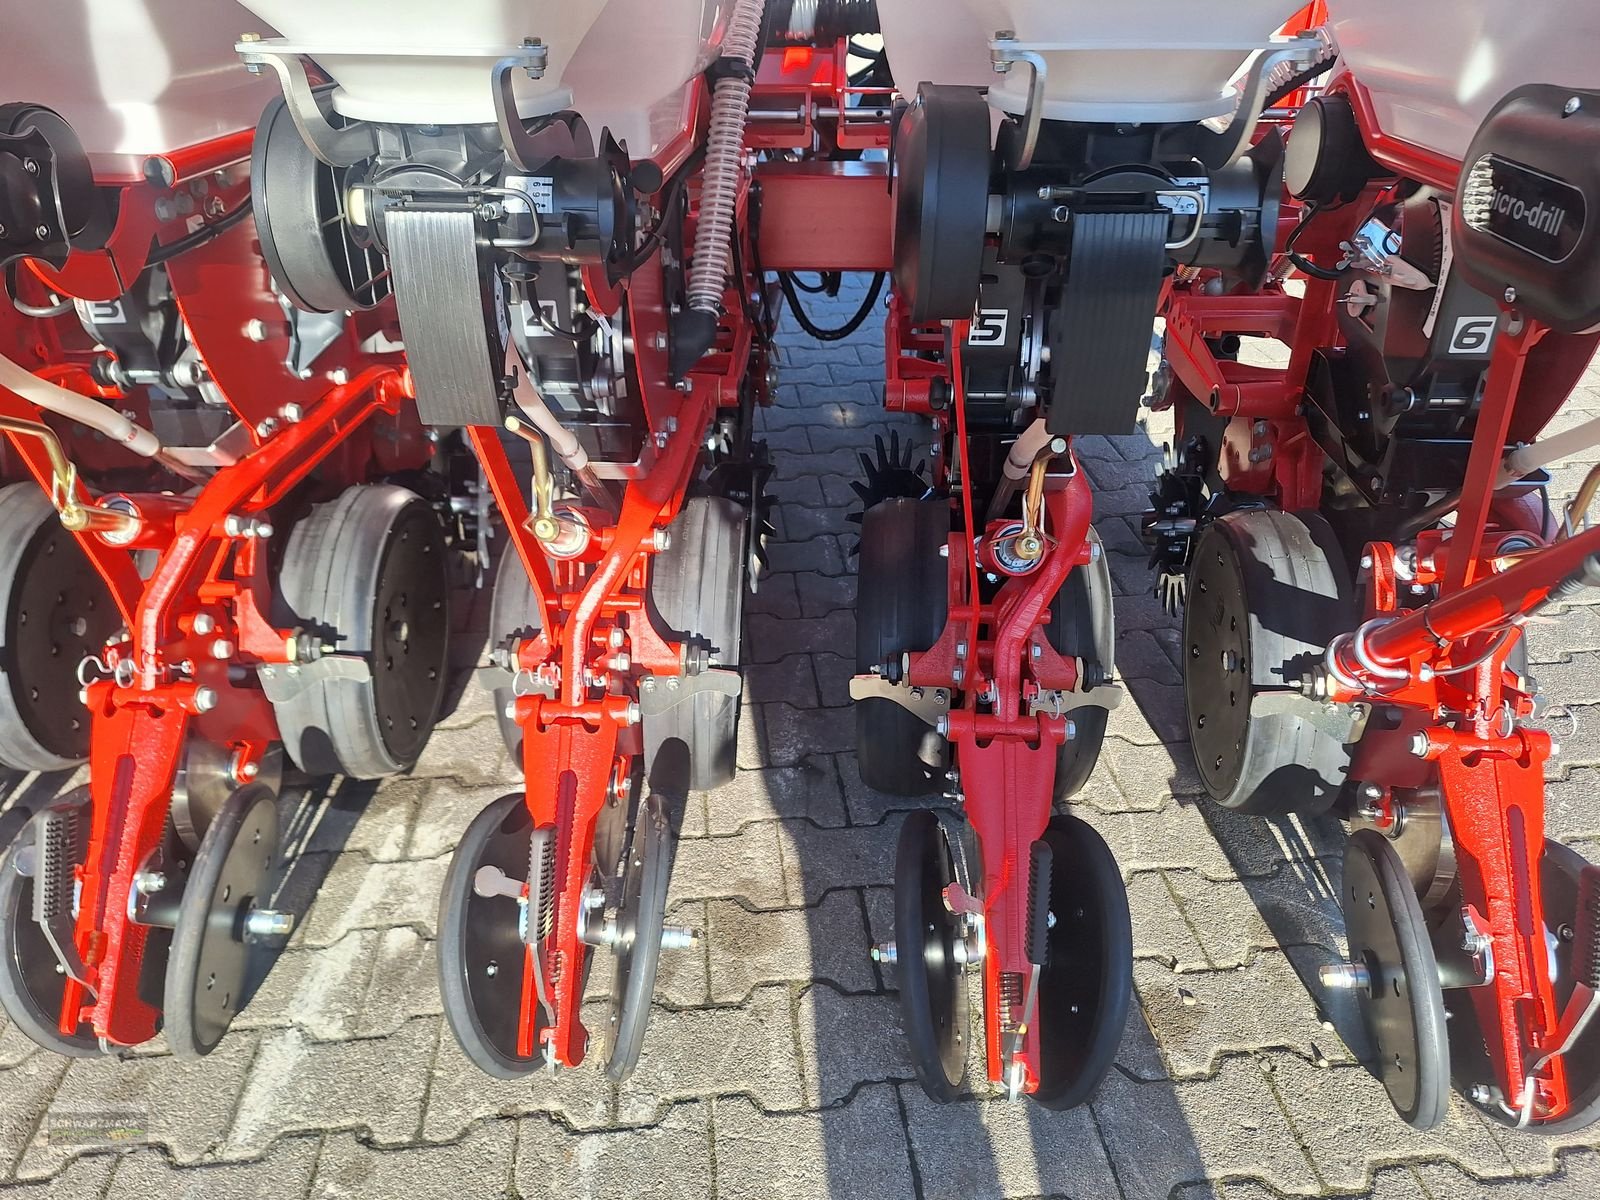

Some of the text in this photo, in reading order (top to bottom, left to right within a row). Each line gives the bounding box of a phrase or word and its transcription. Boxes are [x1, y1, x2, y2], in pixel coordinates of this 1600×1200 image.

[1490, 185, 1565, 236] icro-drill
[970, 314, 1006, 341] 5
[1453, 321, 1493, 349] 6
